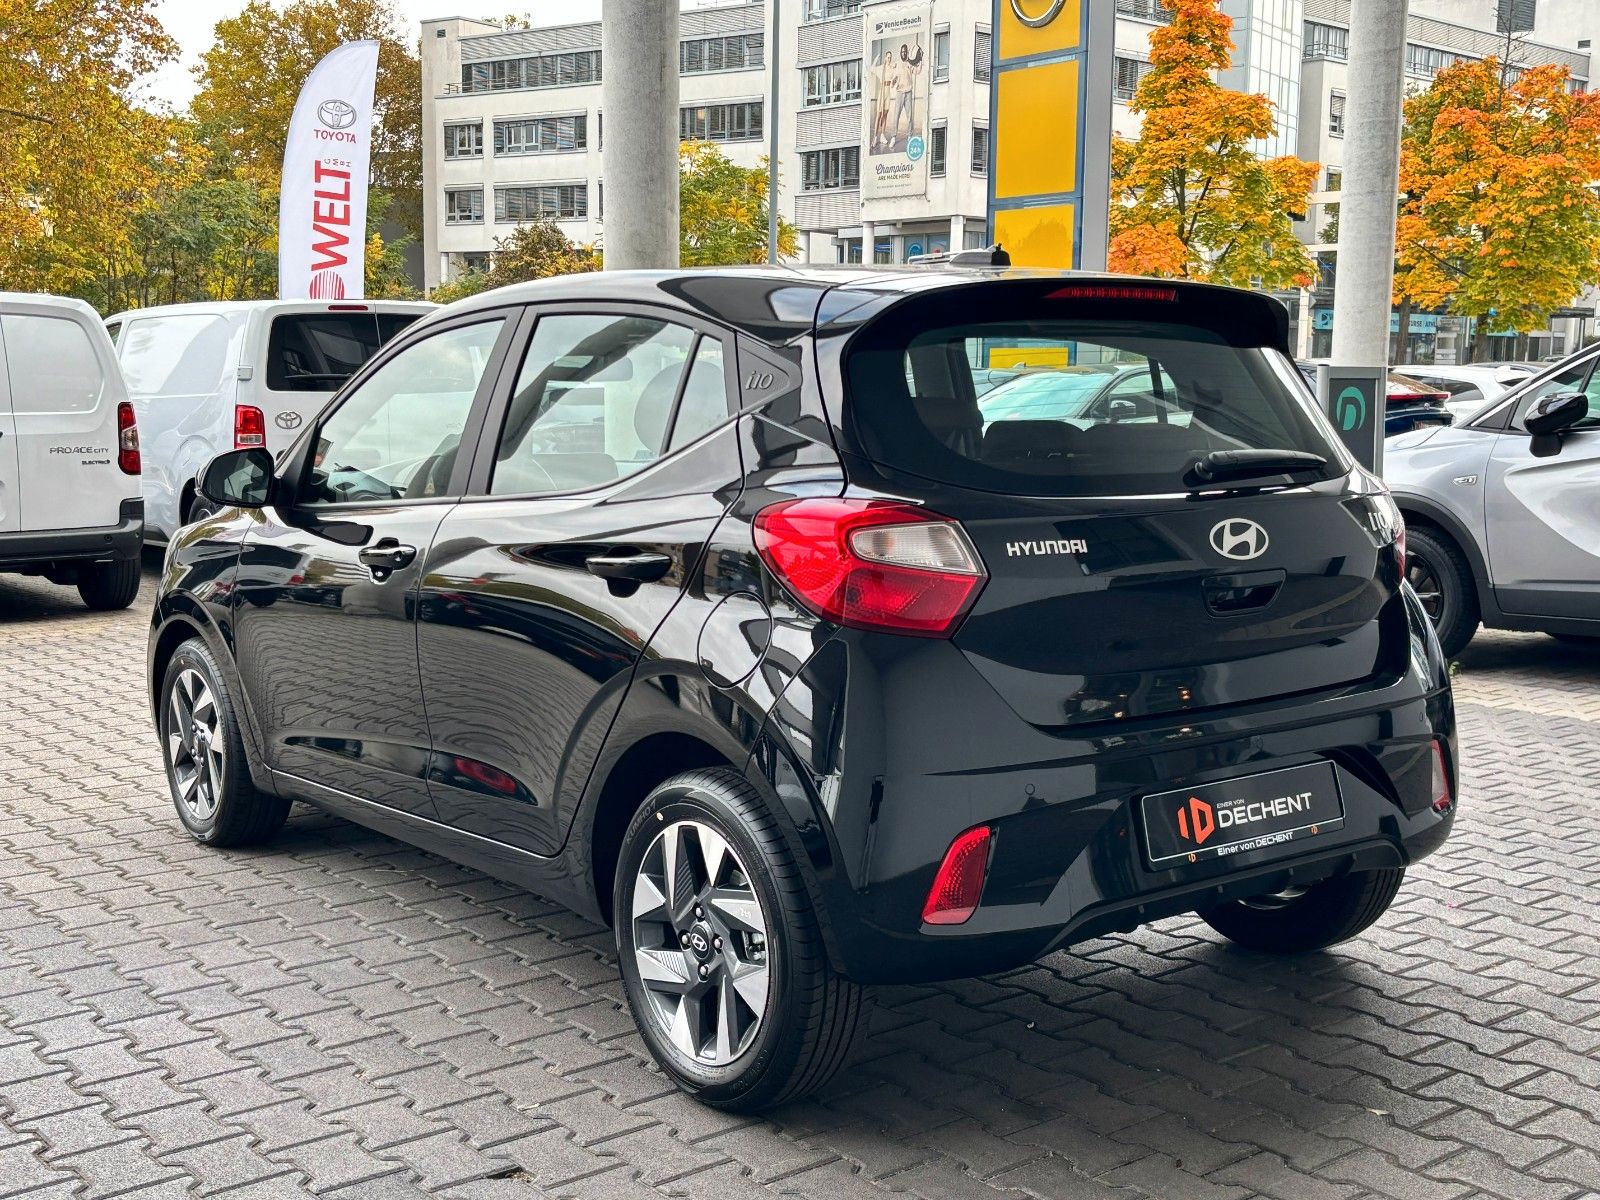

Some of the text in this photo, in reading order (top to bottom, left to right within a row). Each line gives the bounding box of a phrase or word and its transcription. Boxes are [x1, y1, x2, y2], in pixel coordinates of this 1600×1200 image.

[884, 16, 921, 29] VeniceBeach
[314, 129, 356, 144] TOYOTA
[876, 163, 914, 174] Champions
[311, 160, 351, 271] WELT
[1006, 539, 1088, 557] HYUNDAI
[1216, 801, 1233, 809] EINER
[1218, 792, 1312, 828] DECHENT
[1217, 832, 1293, 856] Einer von DECHENT
